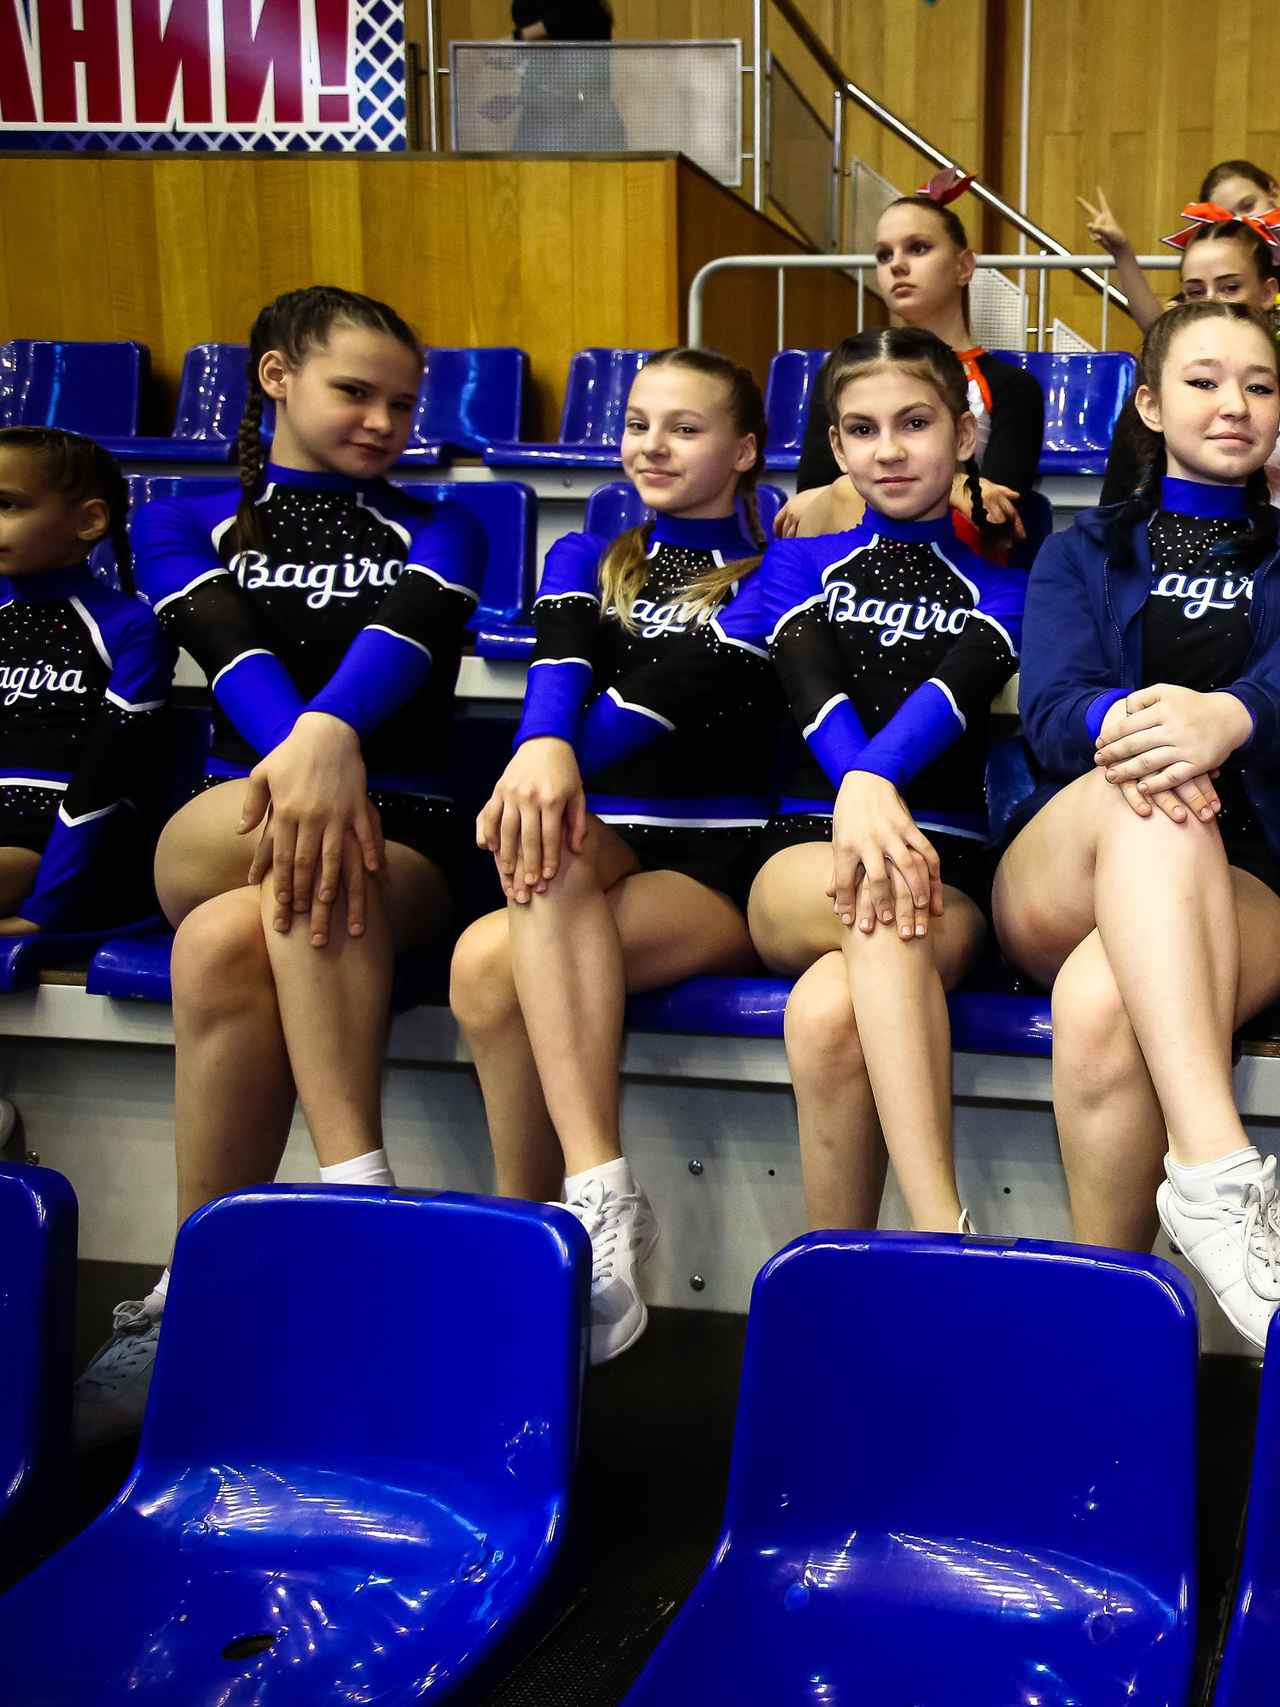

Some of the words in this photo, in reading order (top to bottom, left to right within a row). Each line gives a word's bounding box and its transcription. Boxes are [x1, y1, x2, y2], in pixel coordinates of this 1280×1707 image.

[0, 0, 351, 123] НИИ!
[229, 550, 404, 609] Bagira
[1150, 565, 1253, 620] agir
[824, 580, 972, 647] Bagira
[0, 659, 88, 706] agira
